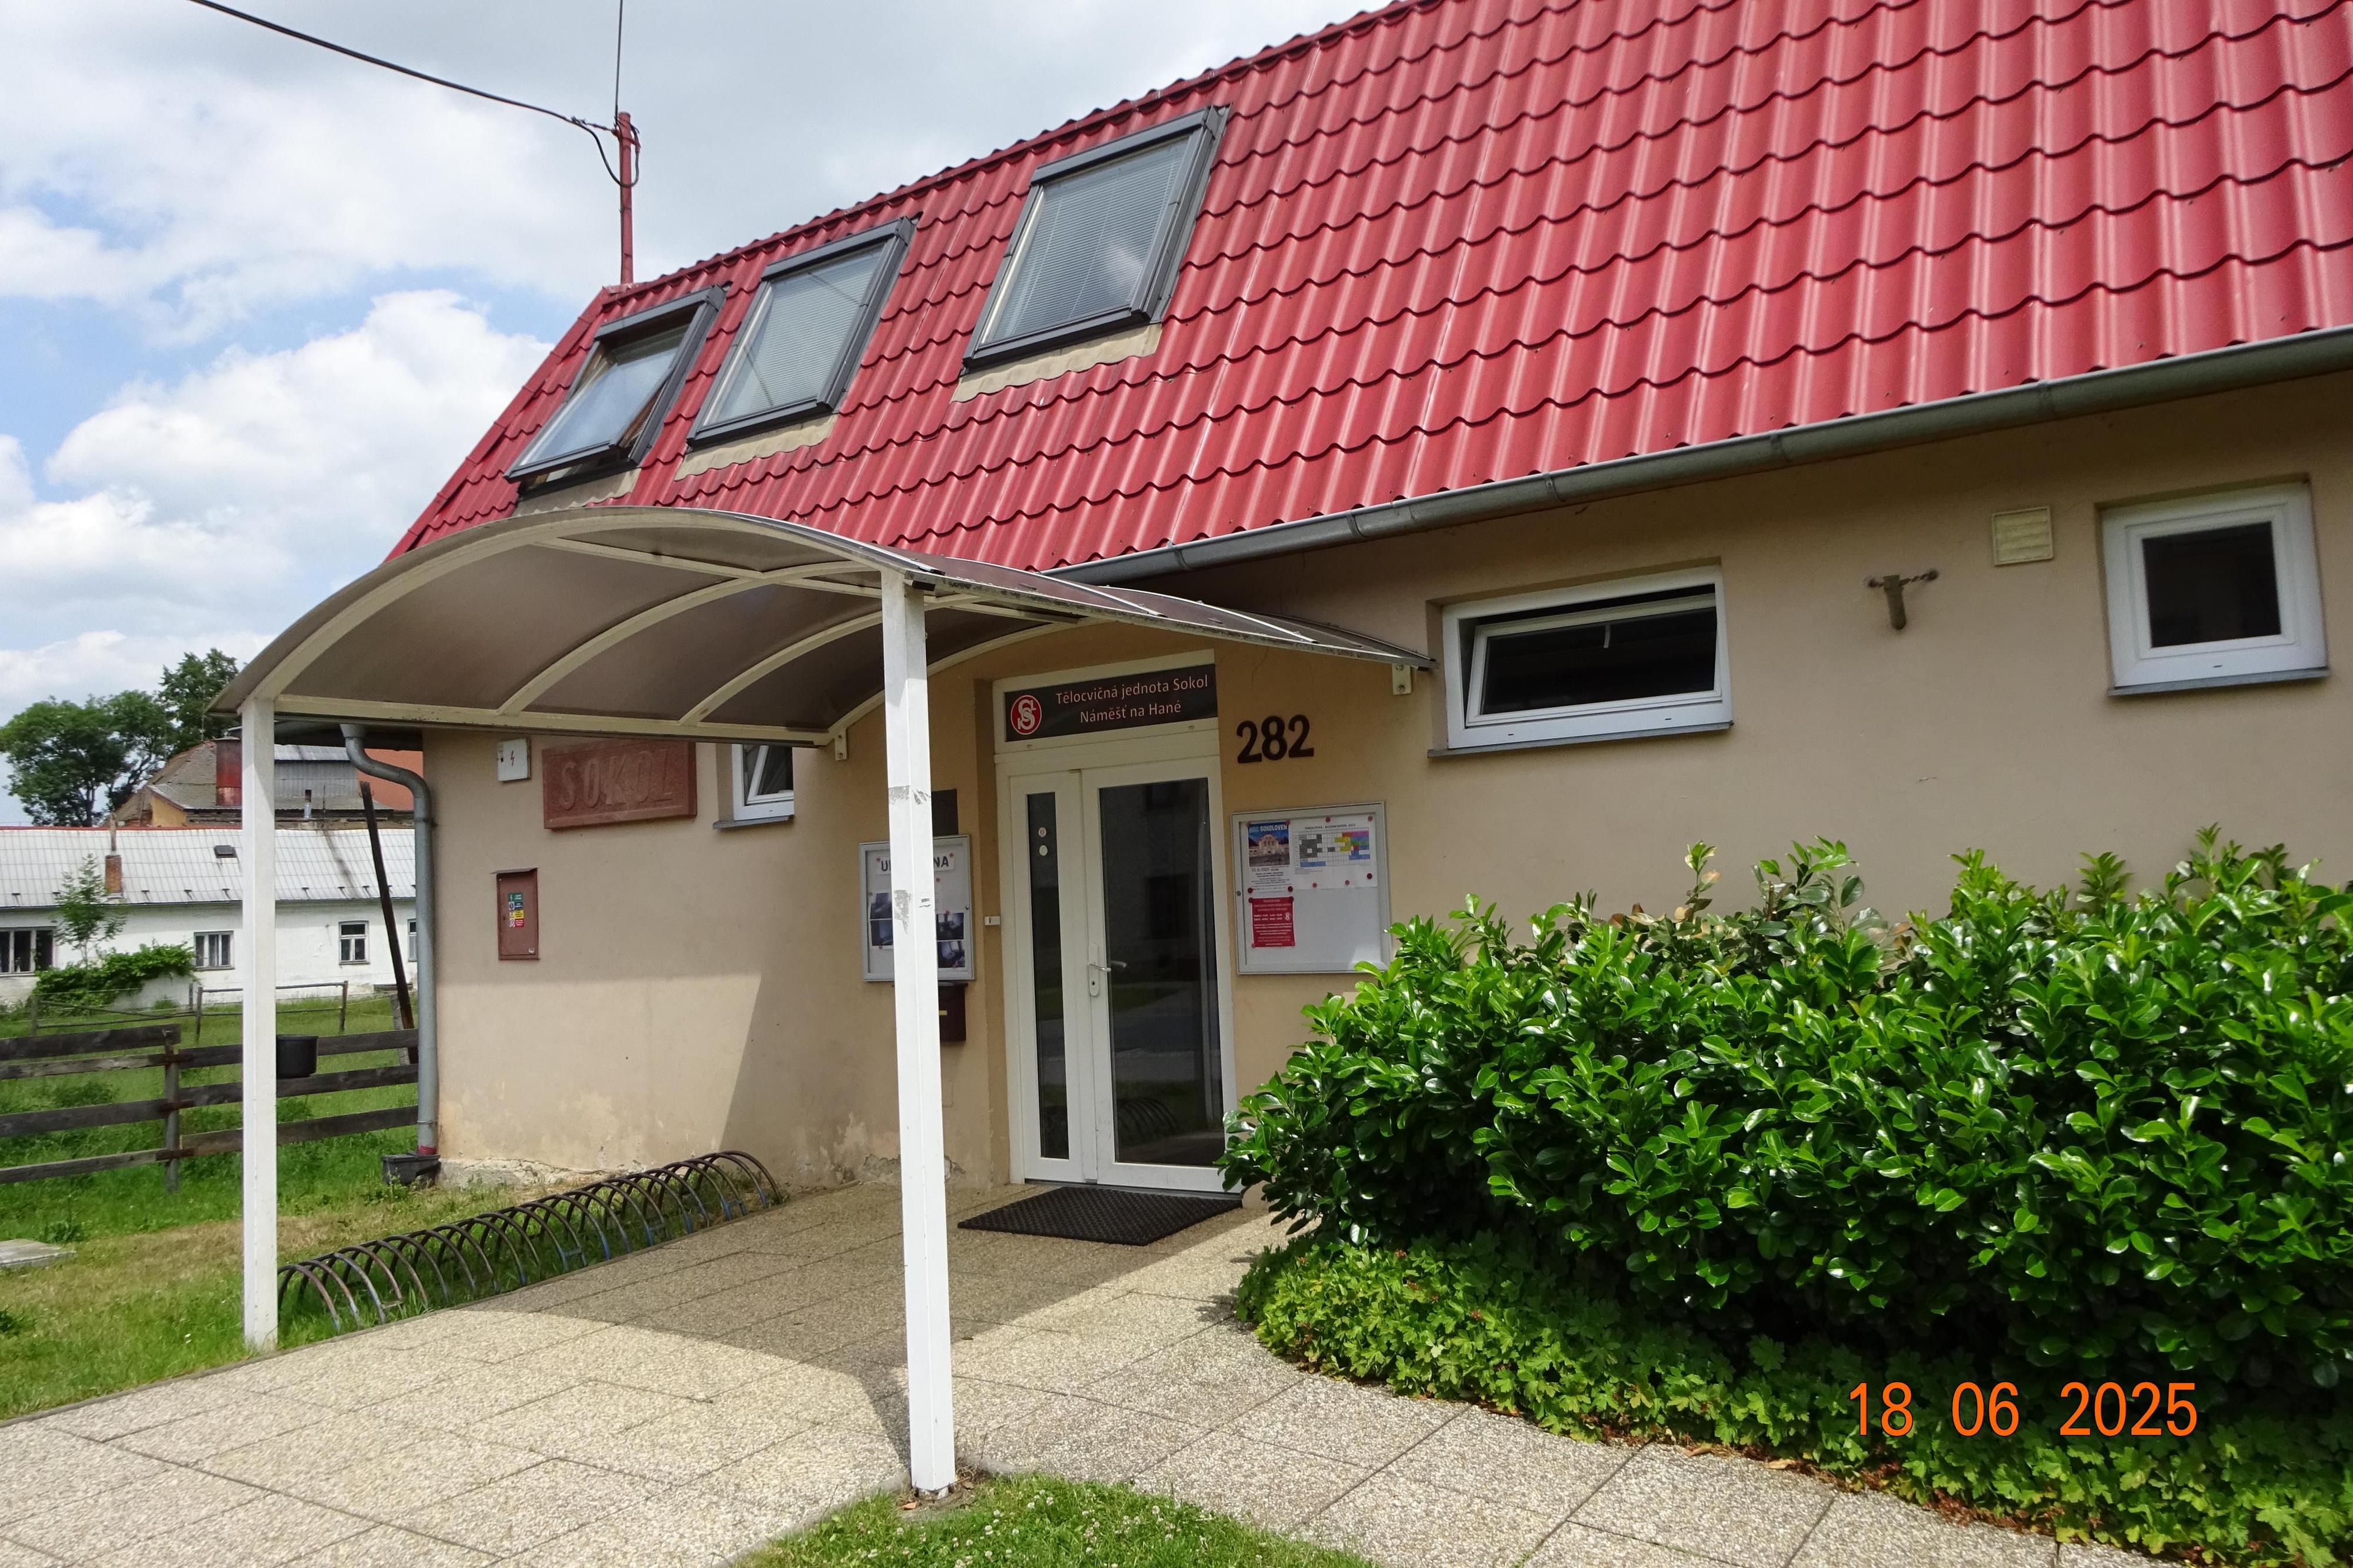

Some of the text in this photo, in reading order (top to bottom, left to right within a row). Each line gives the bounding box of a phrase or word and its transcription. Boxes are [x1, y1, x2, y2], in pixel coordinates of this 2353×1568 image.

[1055, 673, 1208, 705] Tělocvičná jednota Sokol
[1080, 700, 1182, 724] Náměšť na Hané
[1236, 714, 1315, 764] 282
